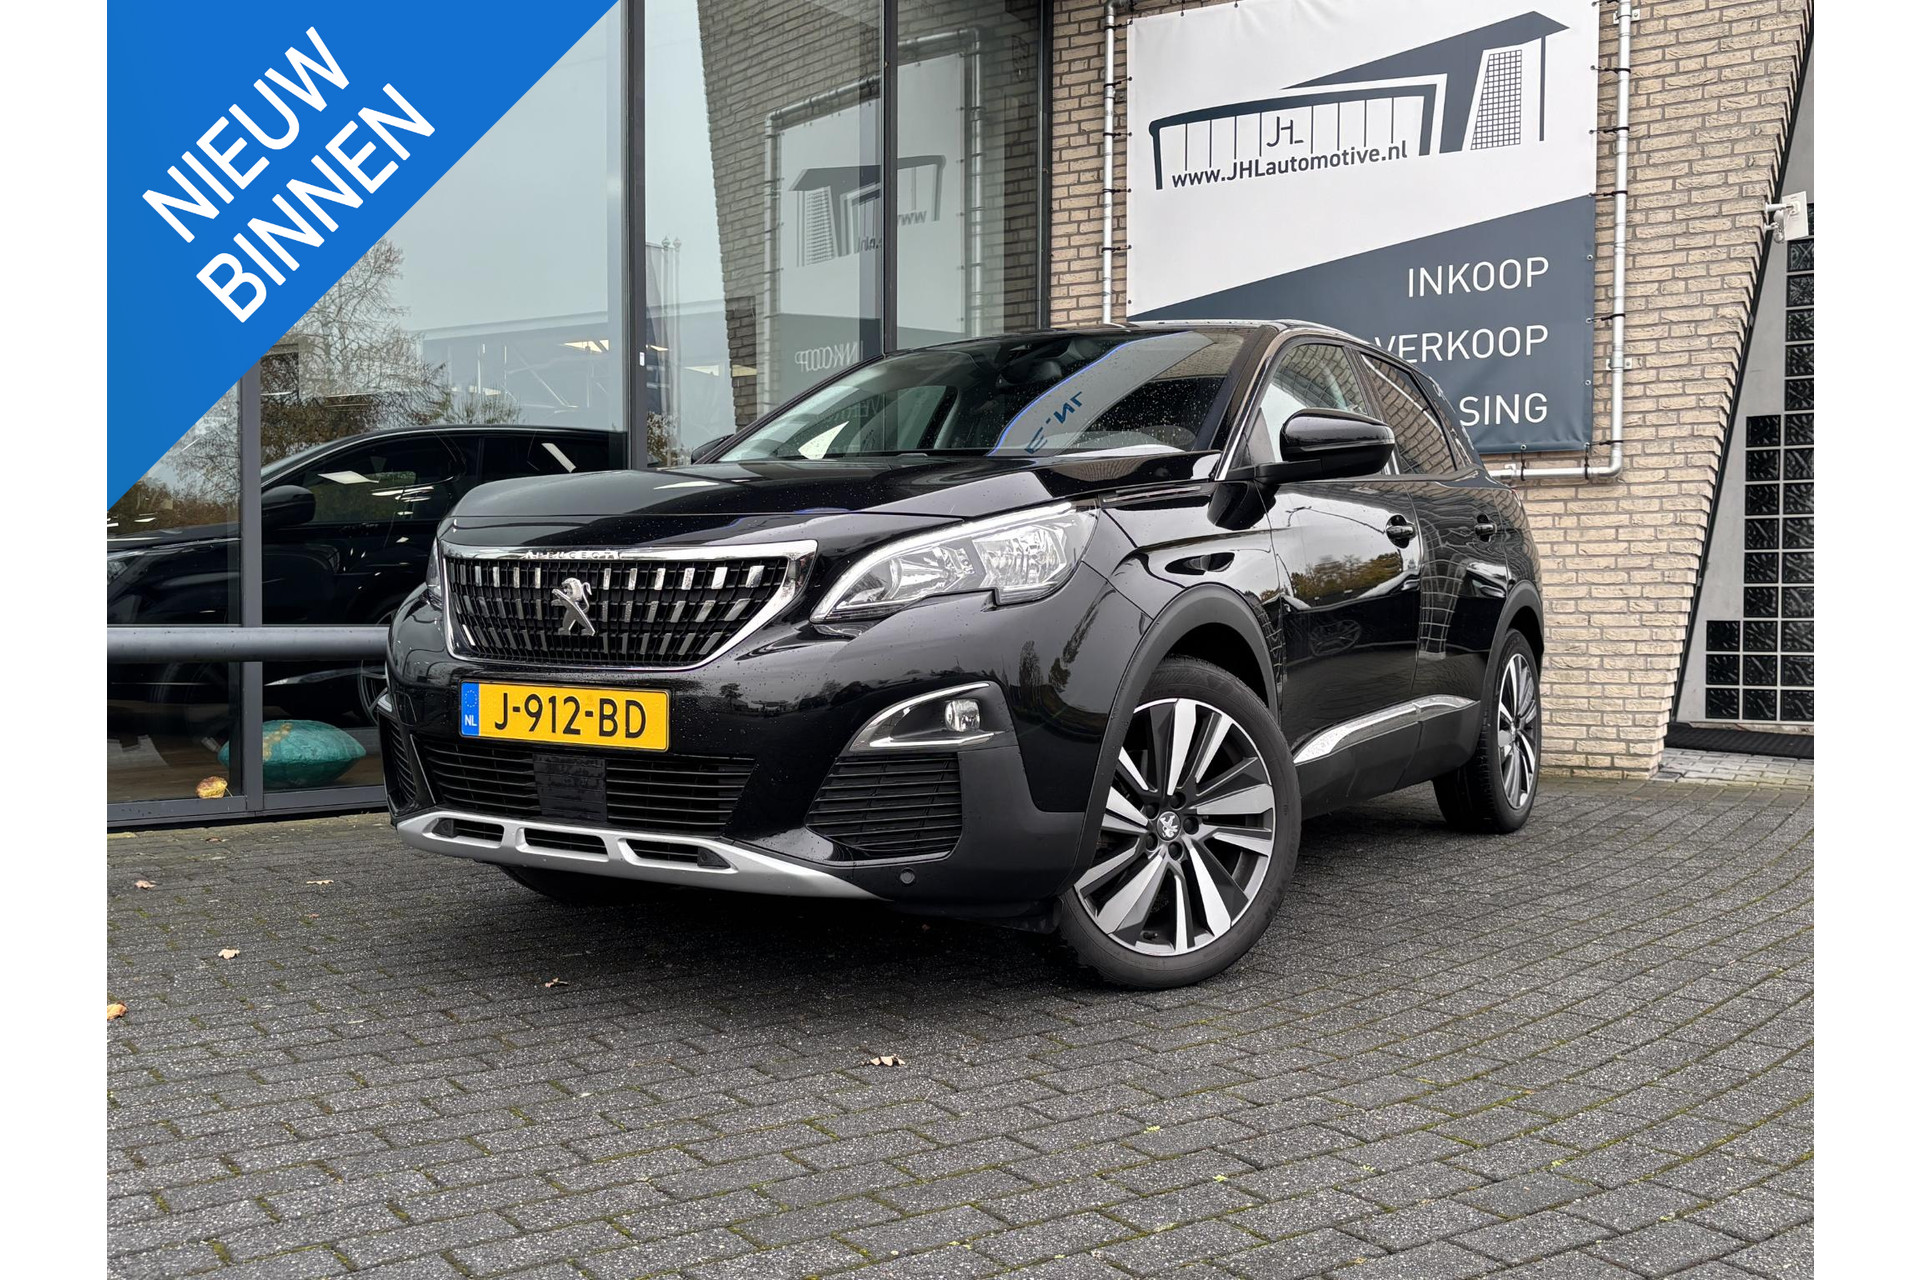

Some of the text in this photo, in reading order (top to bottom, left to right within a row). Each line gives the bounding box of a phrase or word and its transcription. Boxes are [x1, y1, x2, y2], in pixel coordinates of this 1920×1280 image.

[1172, 140, 1408, 188] www.JHLautomotive.nl
[1407, 256, 1549, 298] INKOOP
[463, 713, 478, 728] NL
[494, 692, 647, 739] J-912-BD
